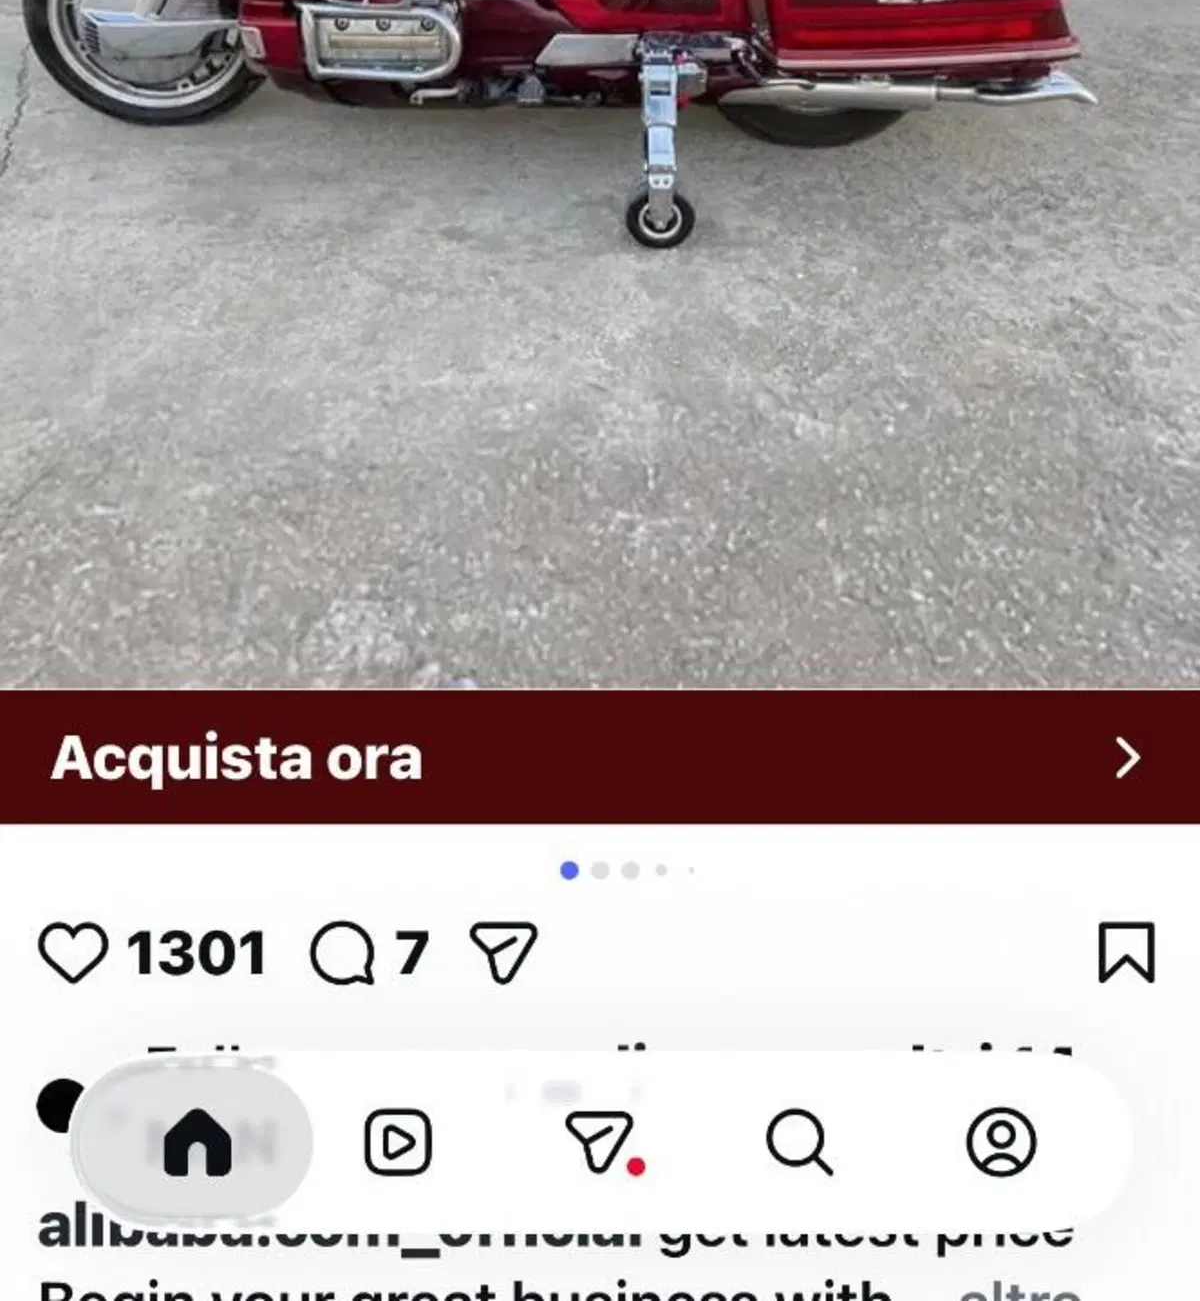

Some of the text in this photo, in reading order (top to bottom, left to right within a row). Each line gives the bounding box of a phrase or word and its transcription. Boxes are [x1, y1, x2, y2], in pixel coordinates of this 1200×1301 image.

[50, 731, 422, 791] Acquista ora
[128, 930, 264, 976] 1301
[396, 930, 429, 975] 7
